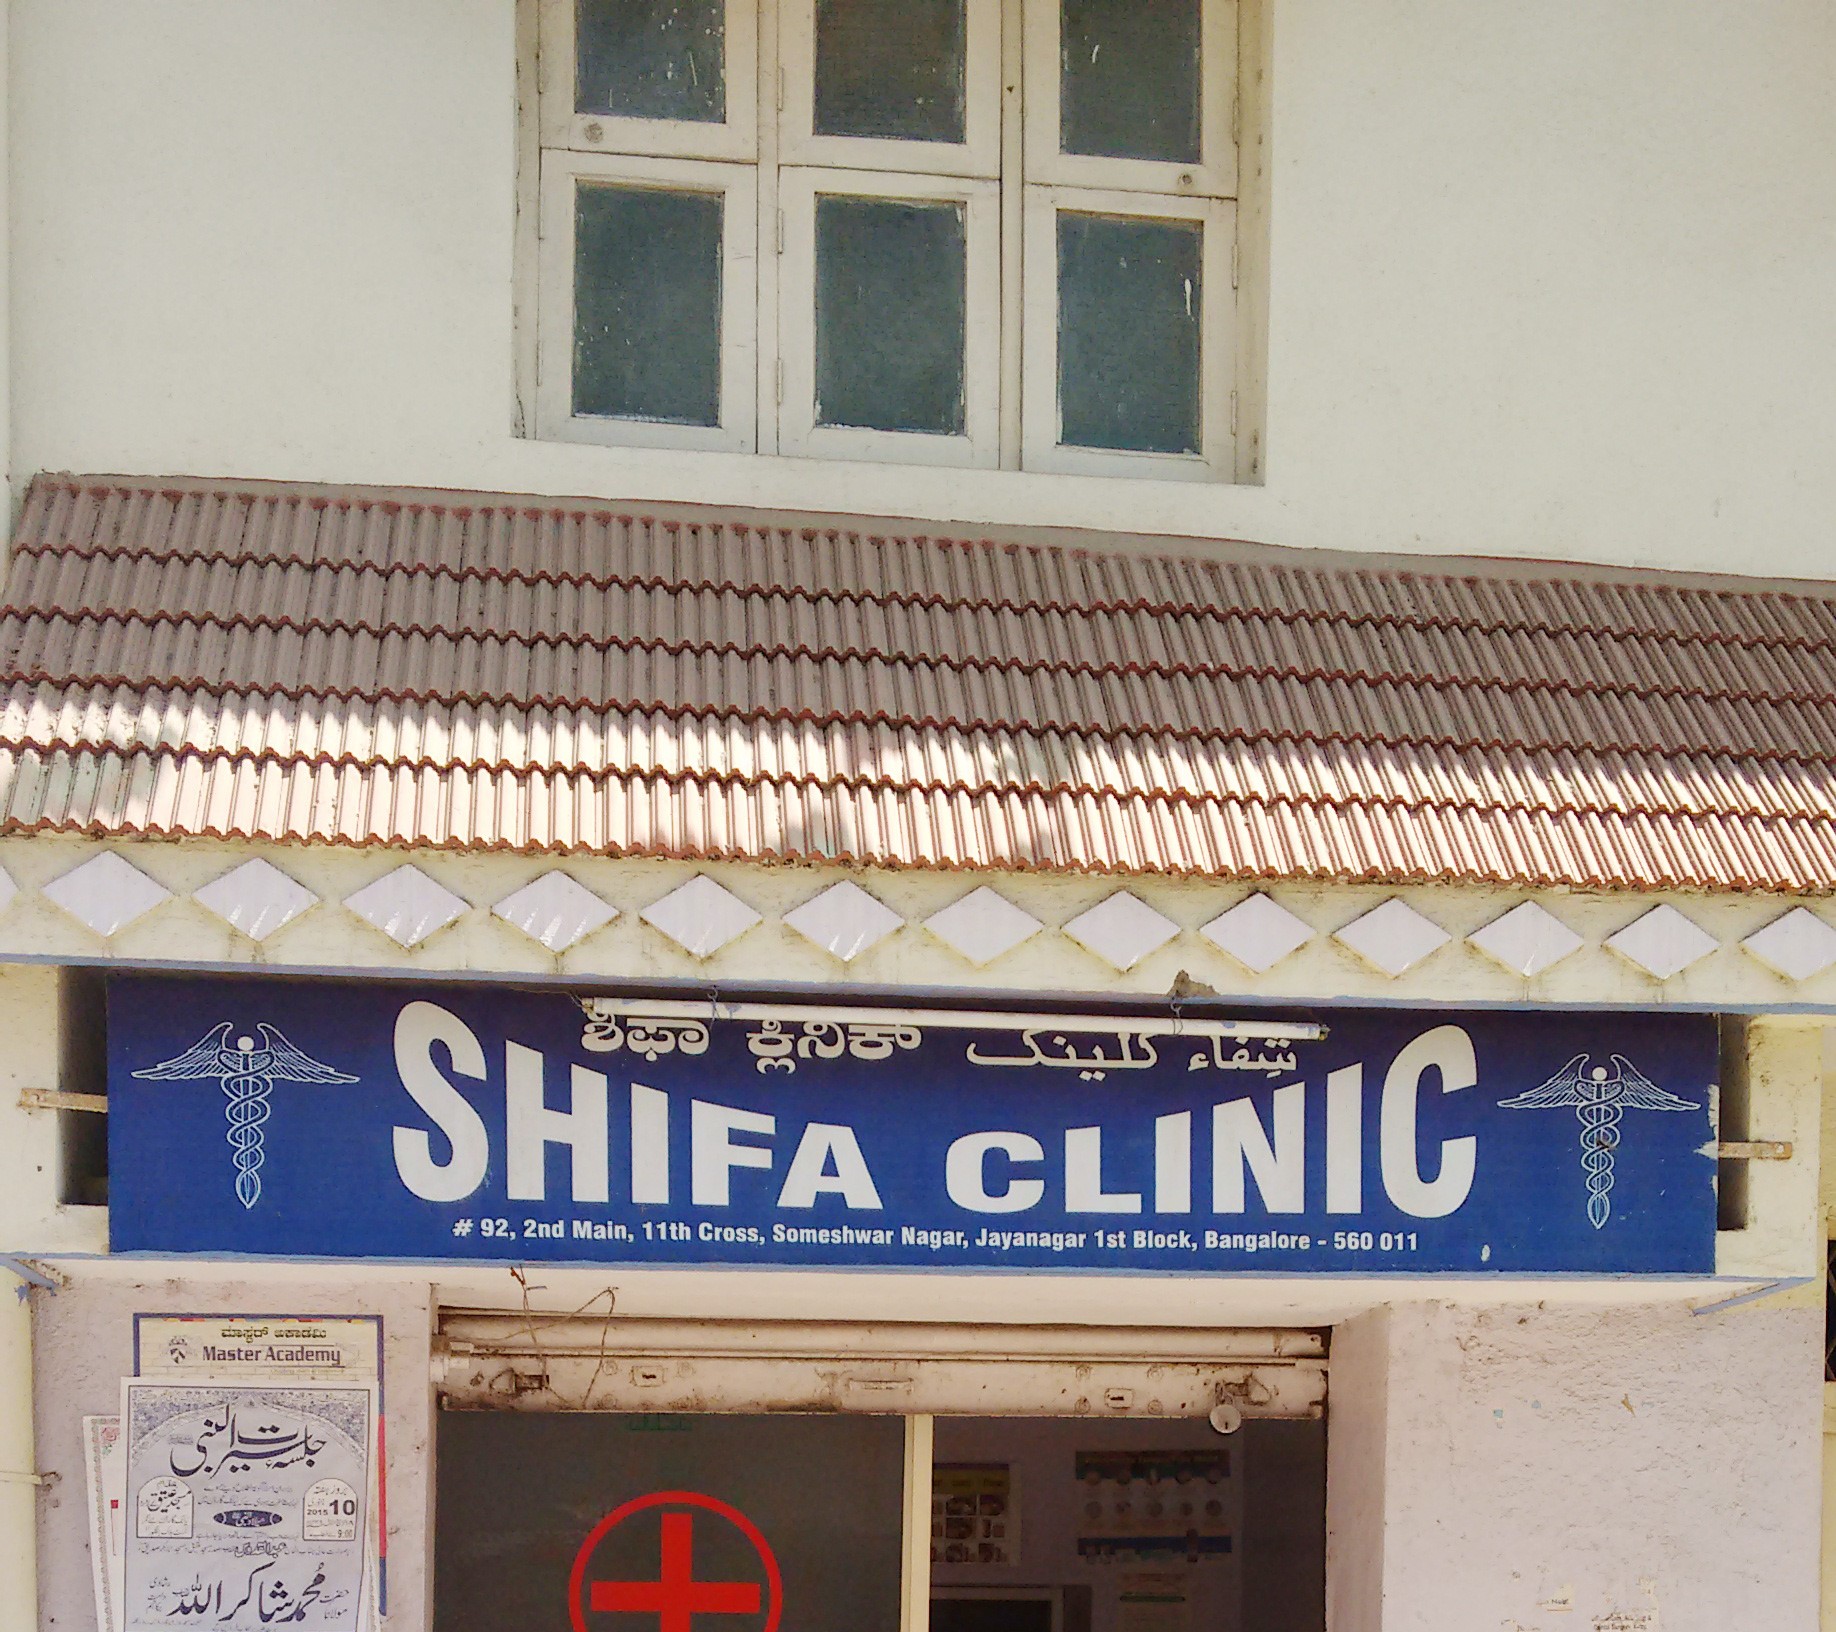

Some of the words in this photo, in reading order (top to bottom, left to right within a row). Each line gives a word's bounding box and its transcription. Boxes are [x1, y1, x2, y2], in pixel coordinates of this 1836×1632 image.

[392, 1000, 884, 1211] SHIFA
[945, 1024, 1478, 1220] CLINIC
[453, 1219, 474, 1237] #
[480, 1218, 516, 1241] 92,
[523, 1219, 565, 1239] 2nd
[572, 1220, 635, 1242] Main,
[642, 1221, 692, 1241] 11th
[698, 1222, 766, 1245] Cross,
[772, 1223, 895, 1246] Someshwar
[901, 1226, 970, 1253] Nagar,
[975, 1226, 1087, 1252] Jayanagar
[1093, 1229, 1127, 1249] 1st
[1133, 1229, 1198, 1252] Block,
[1204, 1230, 1312, 1254] Bangalore
[1333, 1231, 1374, 1251] 560
[1379, 1232, 1418, 1252] 011
[202, 1345, 262, 1362] Master
[264, 1345, 341, 1367] Academy
[328, 1499, 356, 1516] 10
